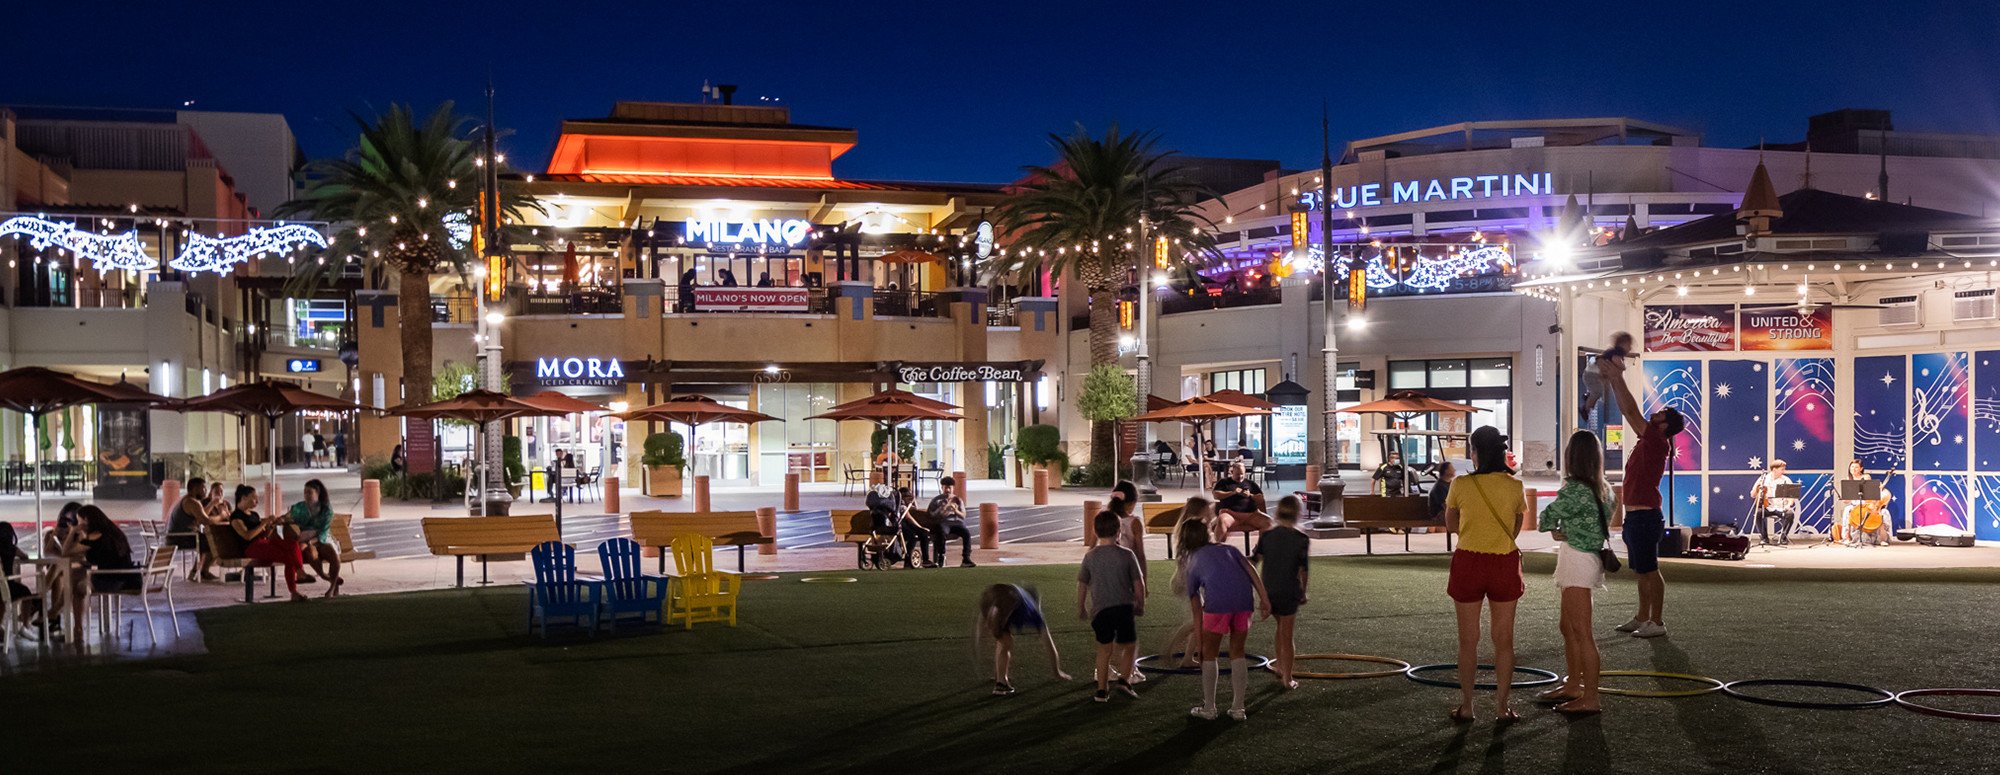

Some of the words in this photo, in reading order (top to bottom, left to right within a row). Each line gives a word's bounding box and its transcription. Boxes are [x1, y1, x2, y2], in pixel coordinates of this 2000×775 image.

[1393, 173, 1552, 203] MARTINI
[685, 217, 813, 245] MILANO
[711, 245, 761, 254] RESTARANT
[769, 246, 786, 254] BAR
[696, 294, 748, 304] MILANO'S
[750, 294, 777, 304] NOW
[779, 294, 807, 304] OPEN
[1645, 308, 1723, 331] America
[1751, 317, 1799, 328] UNITED
[1800, 313, 1815, 328] &
[1680, 328, 1730, 346] Beautiful
[1769, 328, 1821, 339] STRONG
[537, 357, 625, 378] MORA
[899, 367, 927, 383] The
[929, 366, 976, 381] Coffee
[978, 365, 1023, 381] Bean
